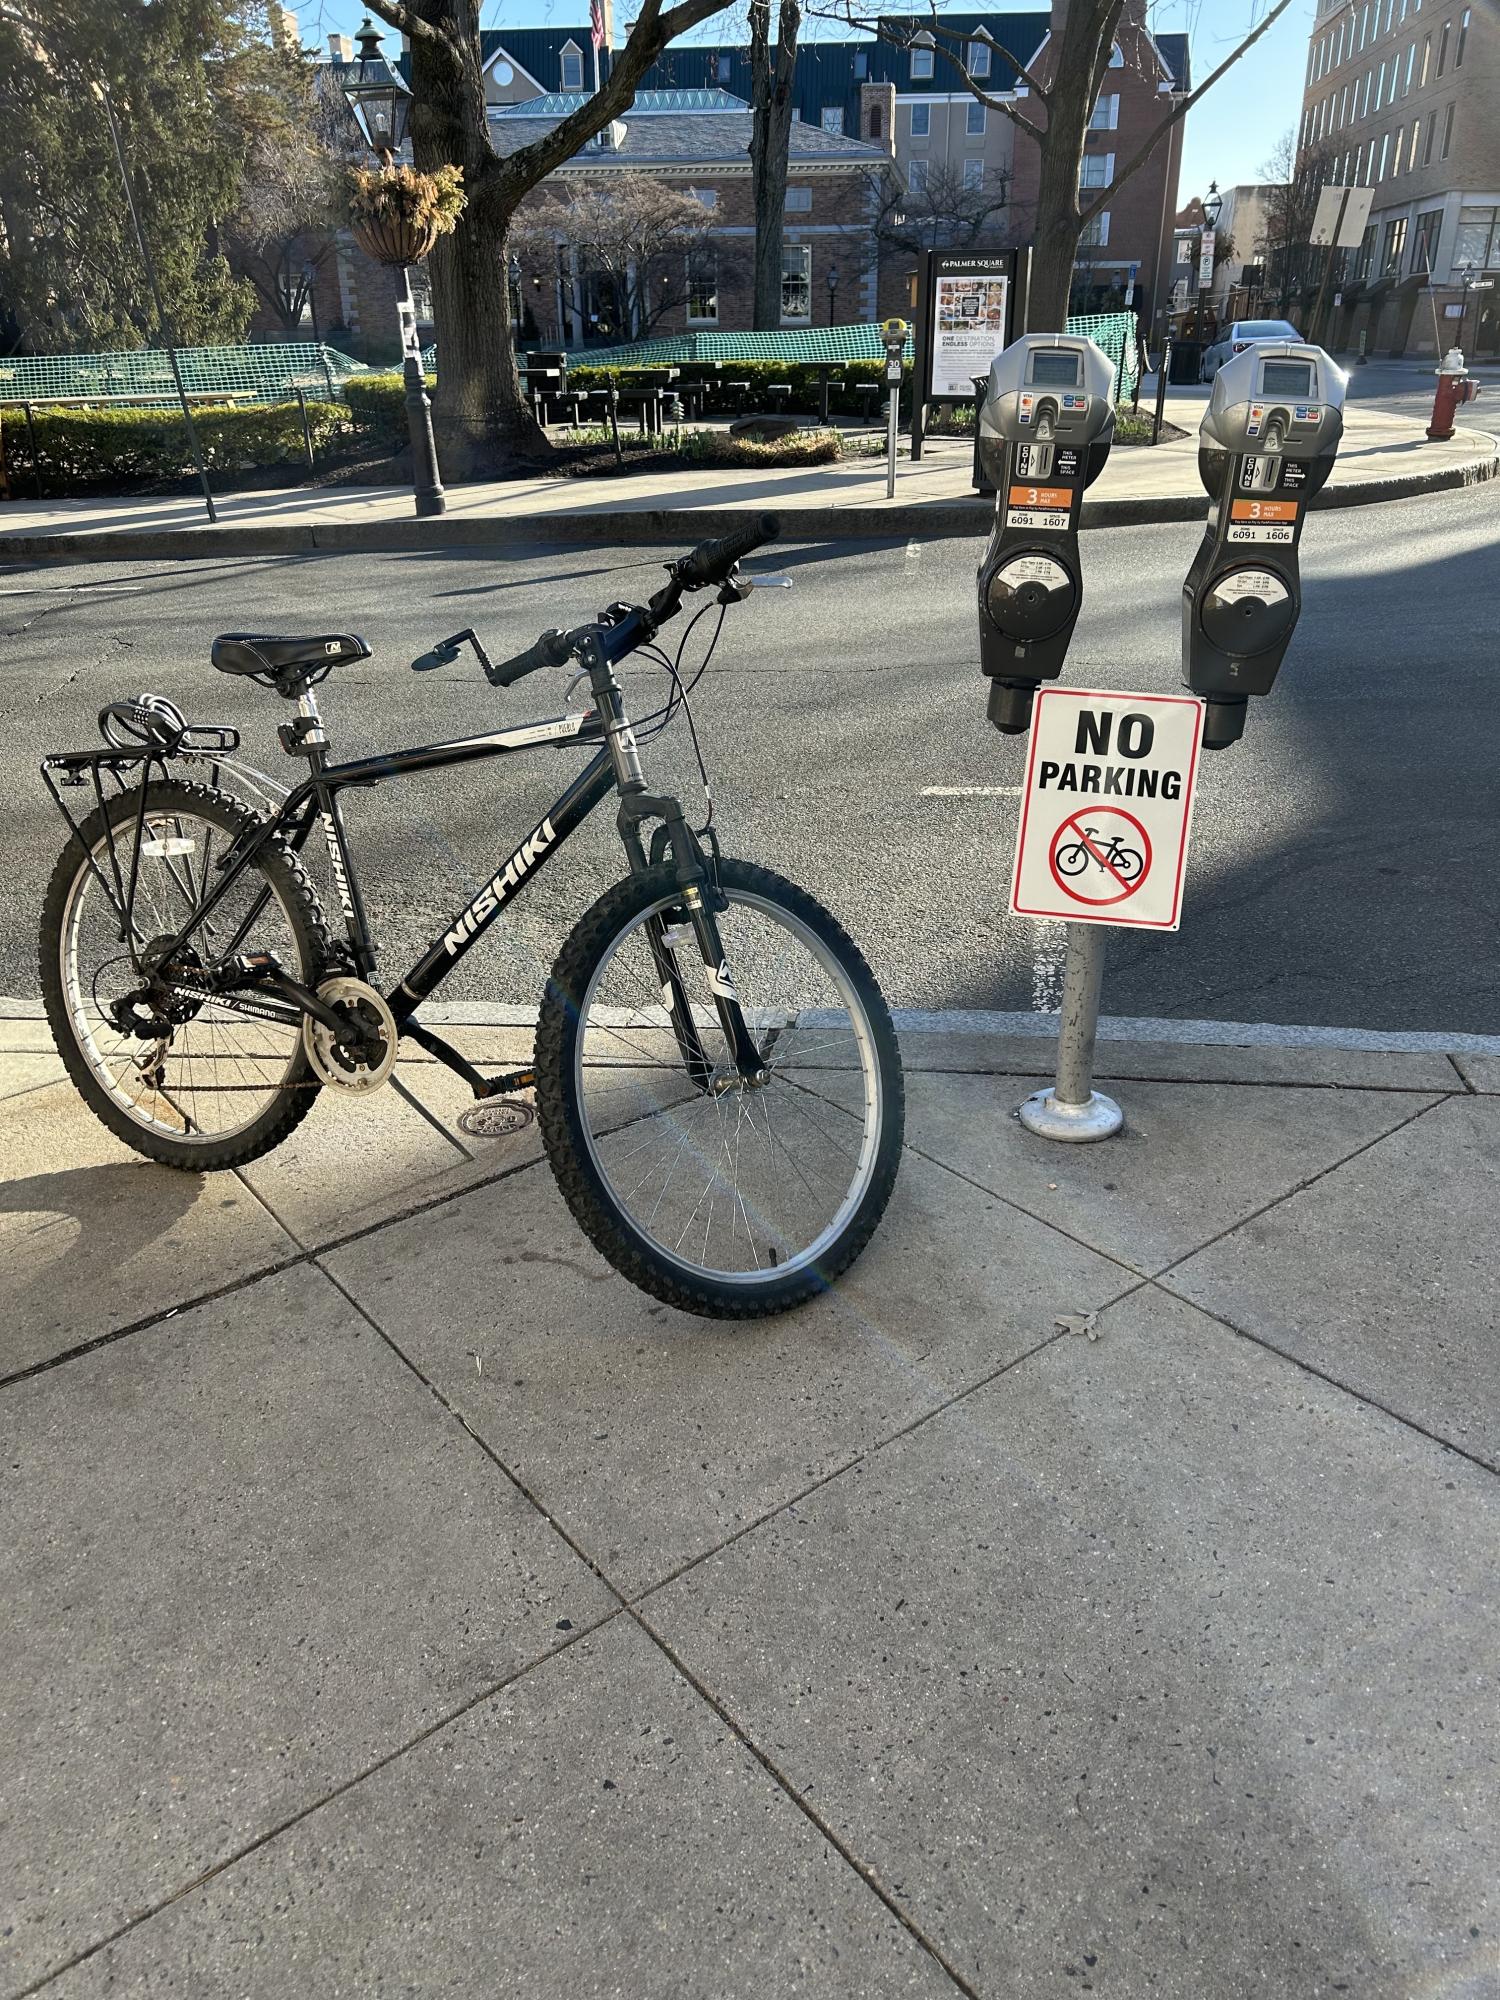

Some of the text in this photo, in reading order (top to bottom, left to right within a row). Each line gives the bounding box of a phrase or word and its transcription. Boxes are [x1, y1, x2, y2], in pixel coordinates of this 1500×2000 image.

[977, 260, 1004, 268] SQUARE
[888, 360, 900, 368] 30
[1020, 446, 1029, 475] COINS
[1244, 457, 1255, 487] COINS
[1026, 489, 1038, 504] 3
[1249, 502, 1261, 518] 3
[1011, 516, 1067, 527] 6091 1607
[1232, 530, 1290, 540] 6091 1606
[1074, 710, 1155, 759] NO
[1038, 761, 1181, 800] PARKING
[320, 811, 355, 918] NISHIKI
[443, 817, 556, 956] NISHIKI
[173, 986, 276, 1018] NISHIKI SHIMANO
